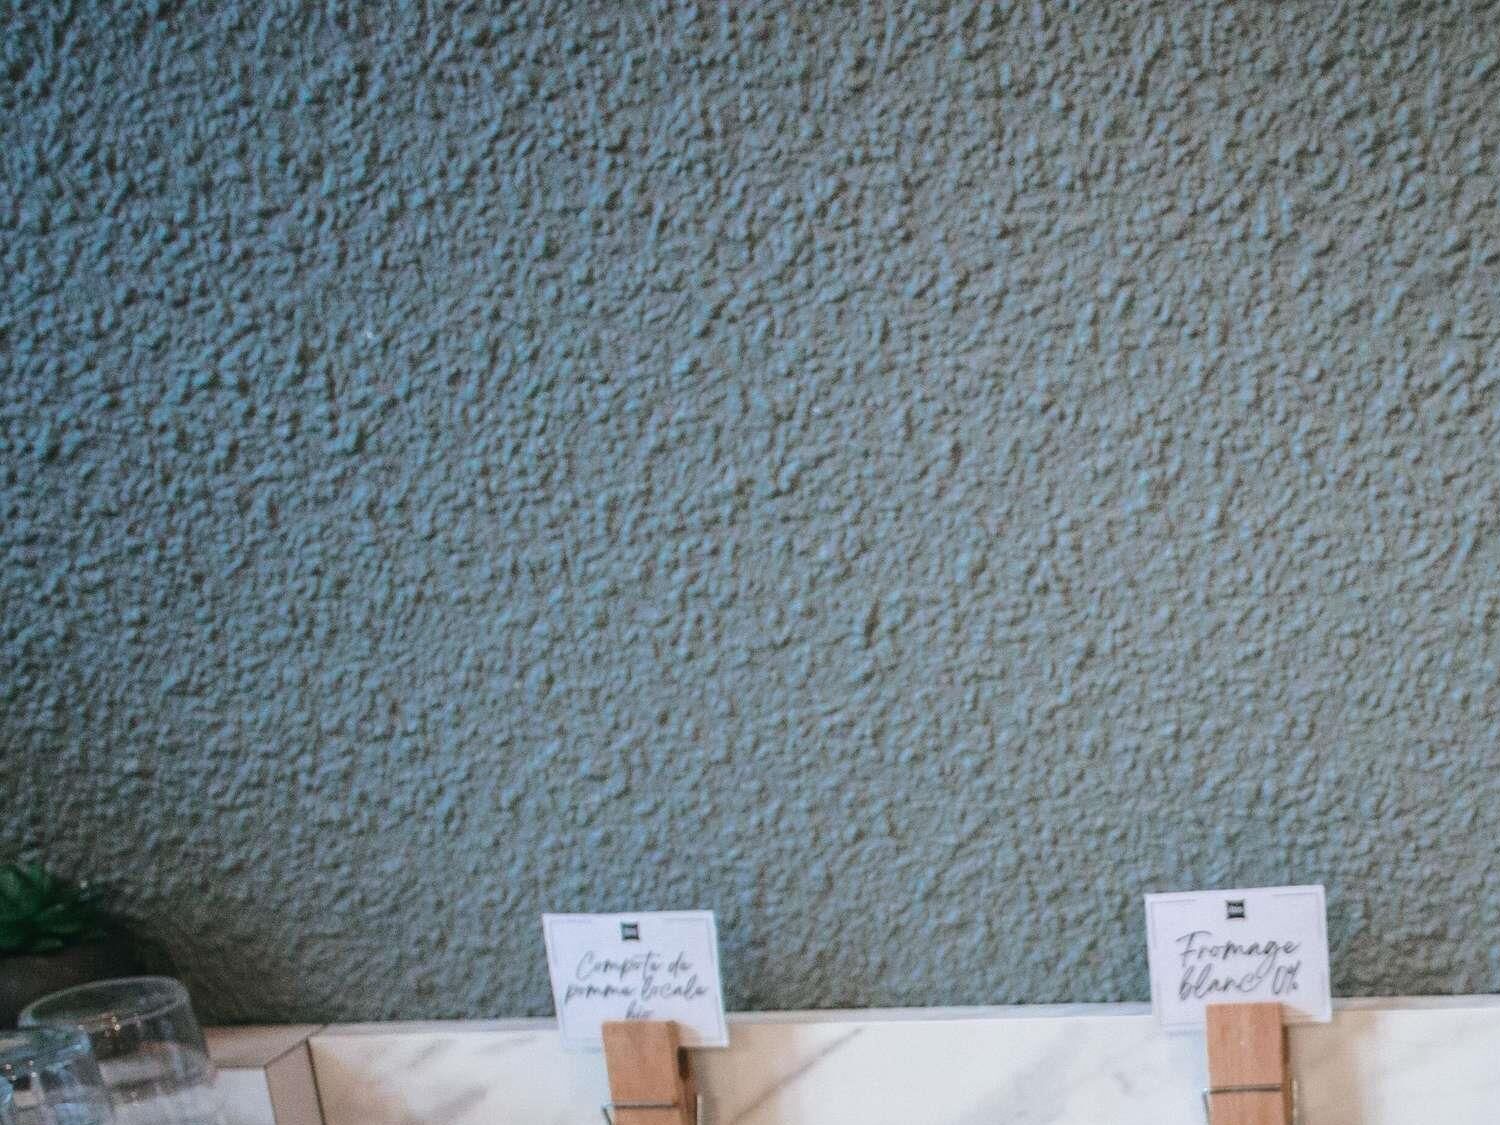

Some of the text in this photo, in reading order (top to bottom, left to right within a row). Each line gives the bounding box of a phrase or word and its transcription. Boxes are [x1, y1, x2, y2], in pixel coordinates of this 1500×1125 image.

[576, 951, 693, 980] Compote de
[1176, 931, 1300, 974] Fromage
[564, 975, 708, 1004] pomme locale
[1179, 961, 1301, 1000] blanc 0%
